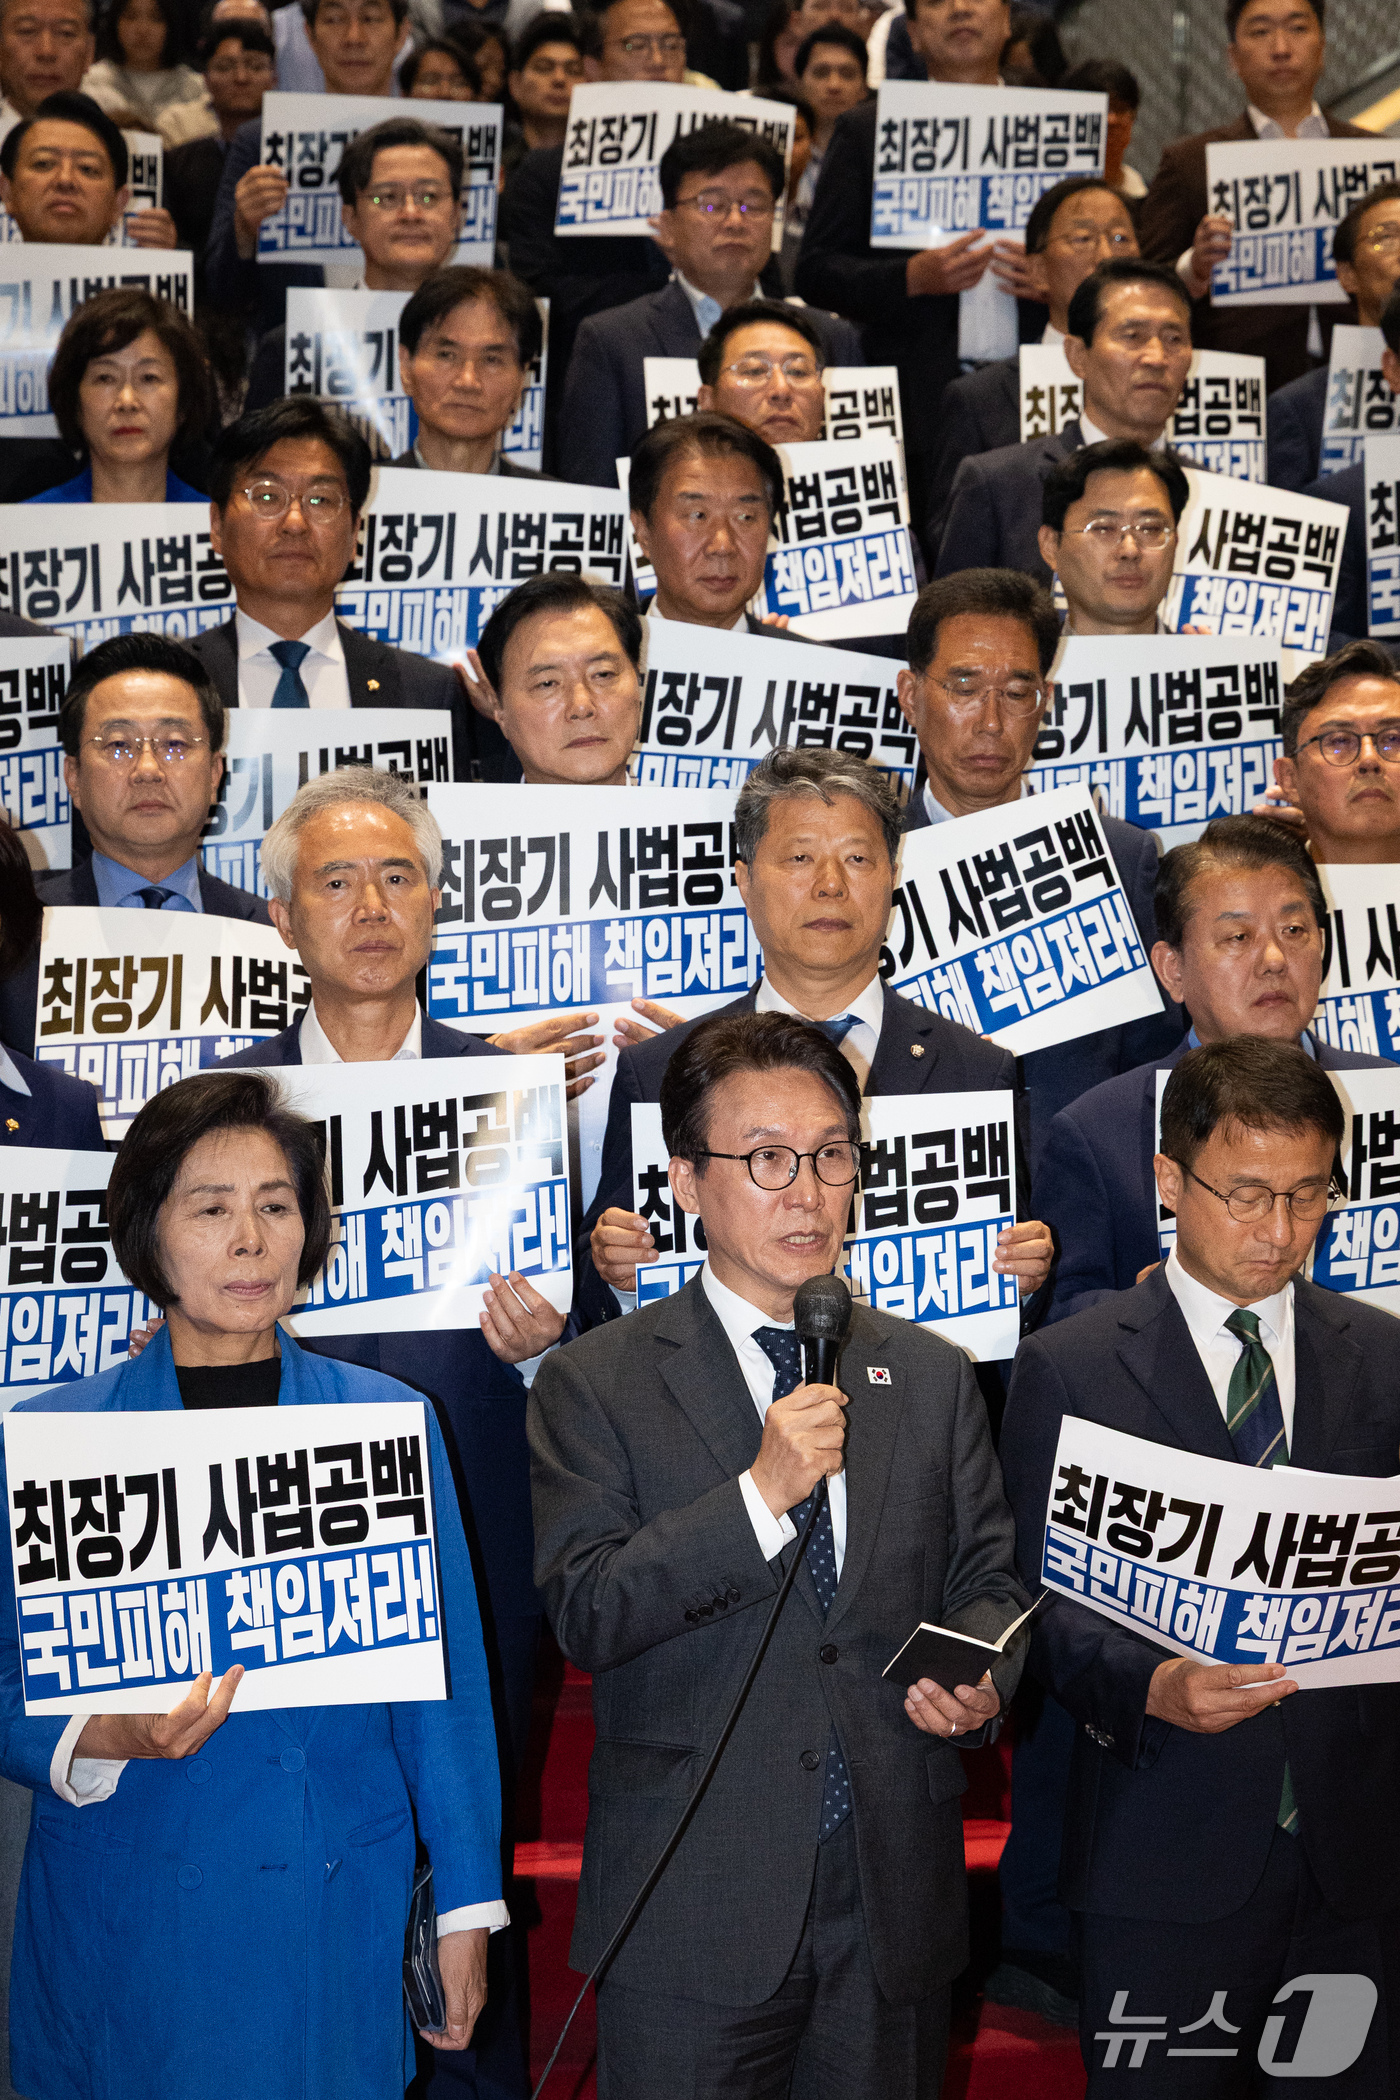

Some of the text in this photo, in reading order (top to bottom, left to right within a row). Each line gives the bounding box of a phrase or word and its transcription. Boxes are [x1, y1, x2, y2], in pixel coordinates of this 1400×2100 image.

[567, 111, 657, 168] 최장기
[879, 113, 1101, 173] 최장기 사법공백
[874, 178, 980, 231] 국민피해
[774, 460, 902, 544] 법공백
[469, 512, 625, 583] 사법공백
[773, 531, 913, 615] 책임져라!
[1187, 508, 1340, 588] 사법공백
[1125, 661, 1282, 748] 사법공백
[589, 821, 739, 911] 사법공
[939, 808, 1117, 947] 사법공백
[40, 954, 183, 1036] 최장기
[430, 924, 591, 1013] 국민피해
[974, 892, 1147, 1017] 책임져라!
[363, 1084, 564, 1199] 사법공백
[846, 1121, 1011, 1233] 법공백
[0, 1189, 112, 1286] 법공
[12, 1435, 428, 1586] 최장기 사법공백
[1051, 1463, 1224, 1578] 최장기
[20, 1546, 439, 1691] 국민피해 책임져라!
[1047, 1528, 1228, 1655] 국민피해
